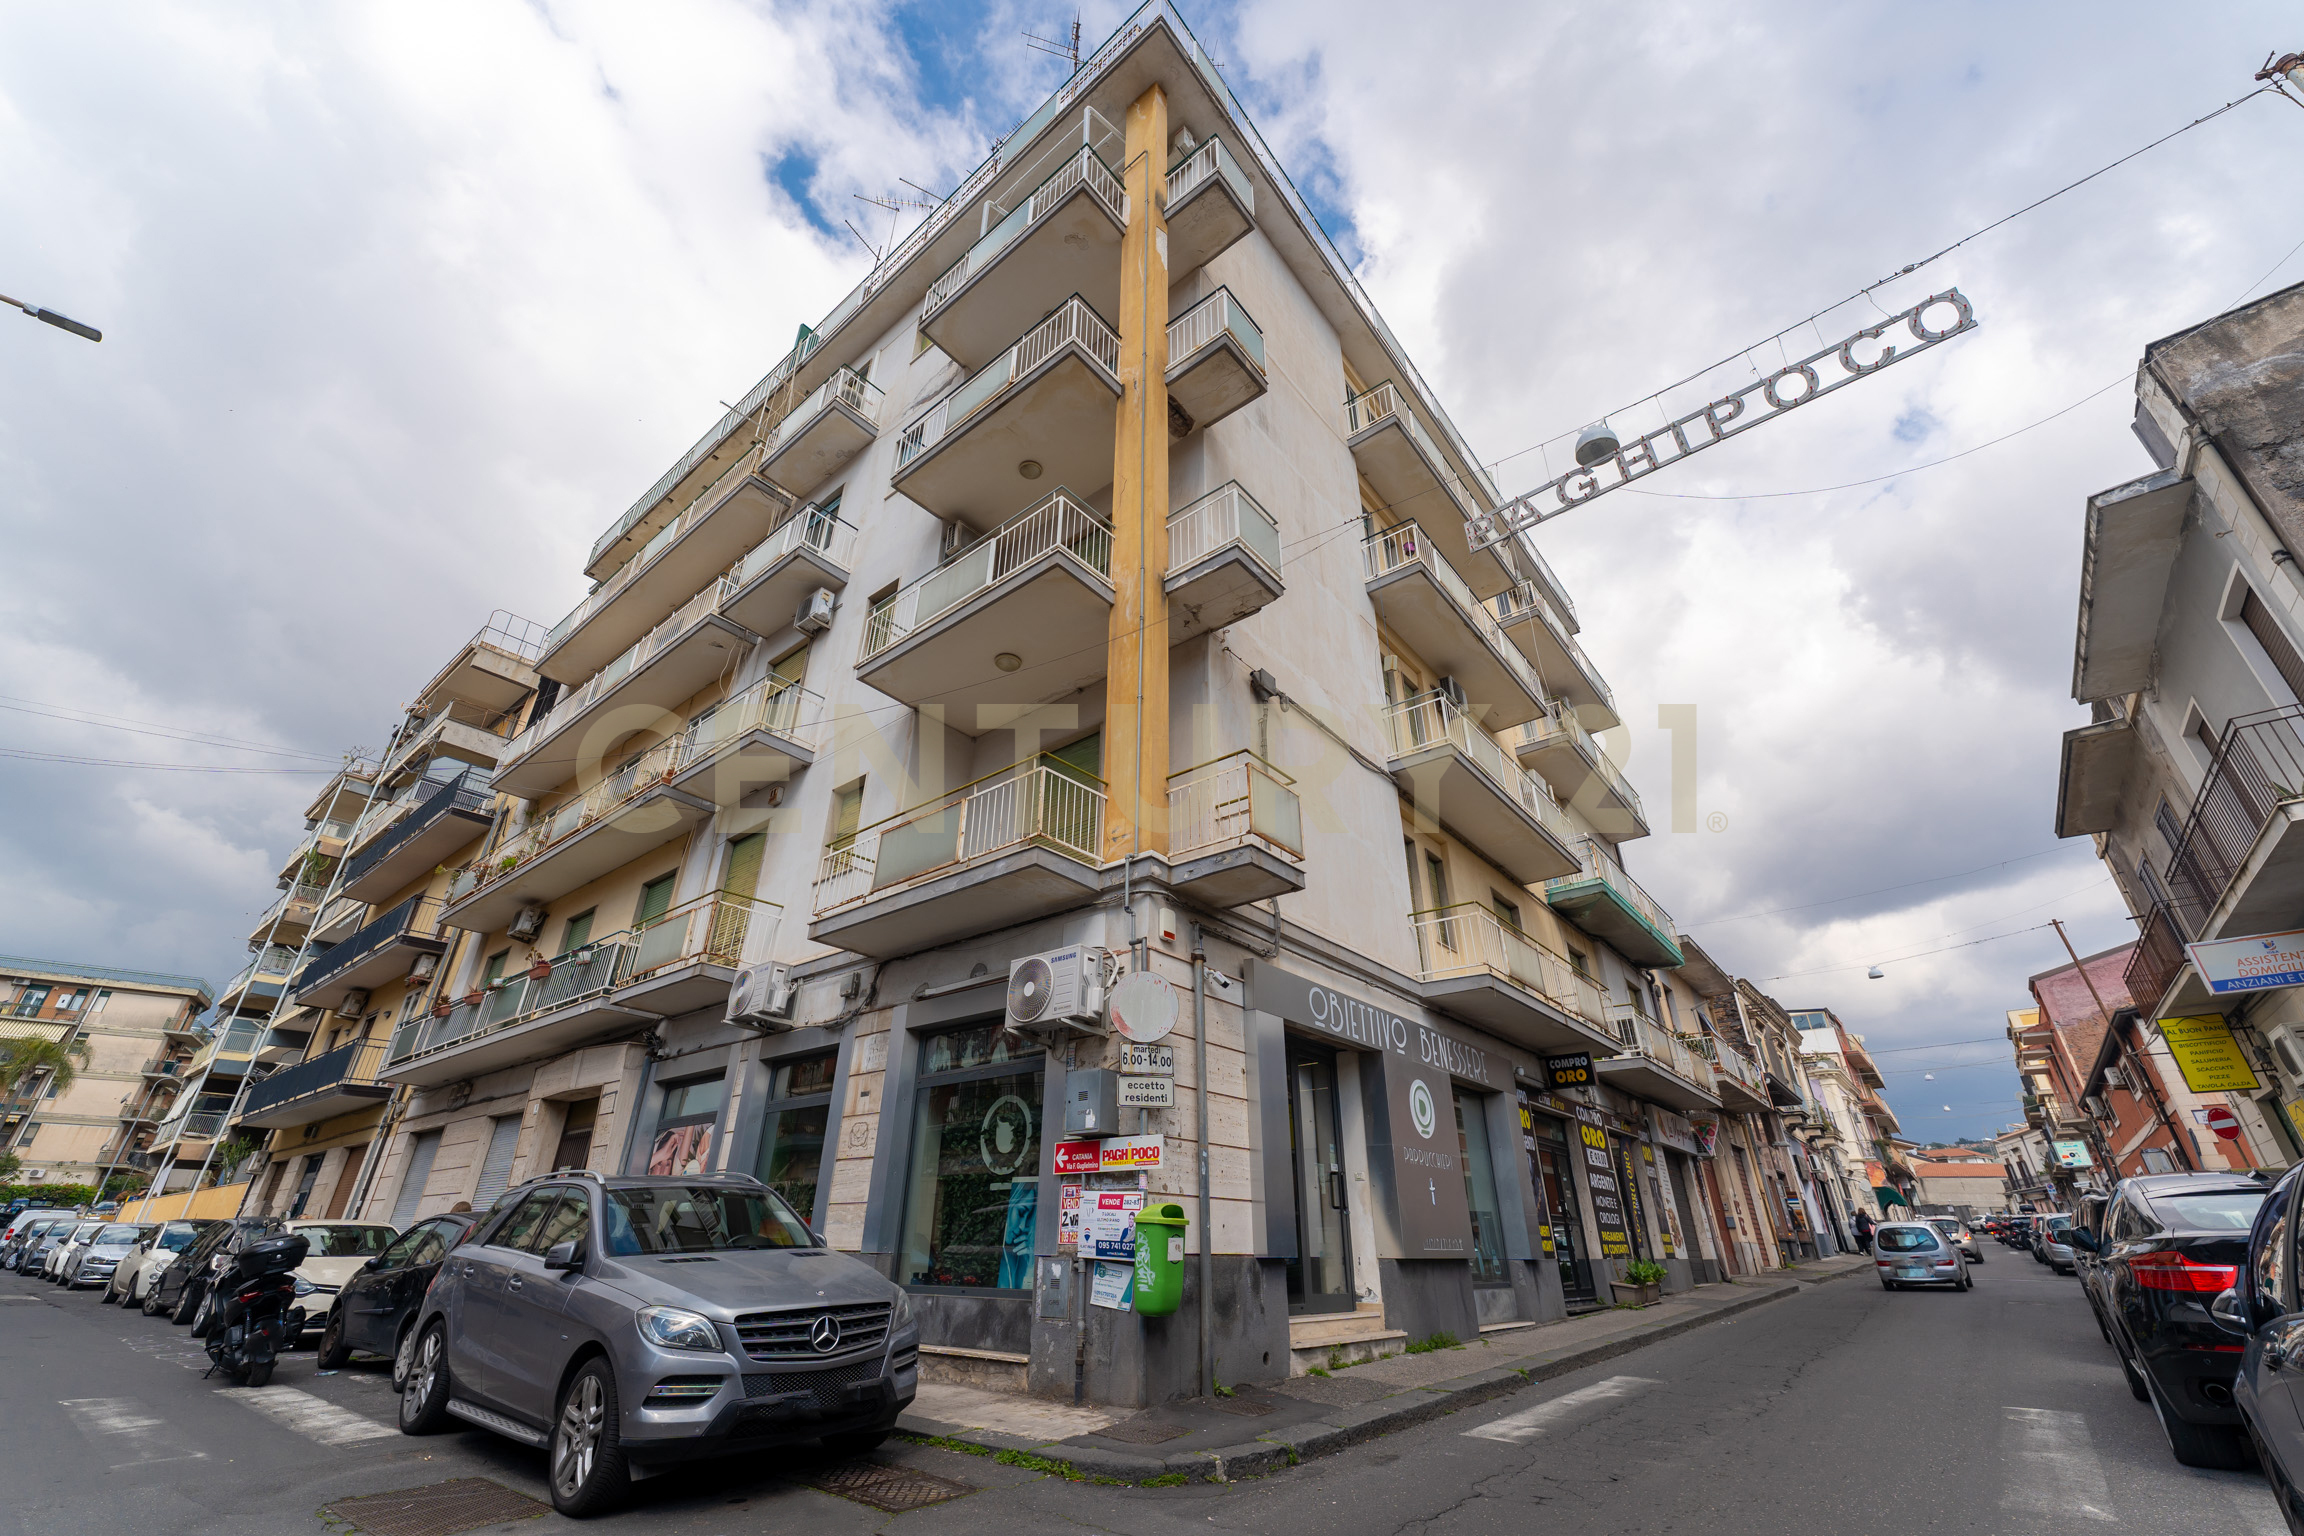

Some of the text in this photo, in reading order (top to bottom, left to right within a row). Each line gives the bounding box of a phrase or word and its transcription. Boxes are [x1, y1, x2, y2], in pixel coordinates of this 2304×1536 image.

[1050, 952, 1077, 963] SAMSUNG
[2227, 975, 2284, 990] ANZIANI
[2287, 973, 2297, 983] E
[1309, 986, 1489, 1084] OBIETTIVO BENESSERE
[2178, 1040, 2227, 1048] BISCOTTIFICIO
[1549, 1056, 1588, 1069] COMPRO
[1555, 1068, 1587, 1083] ORO
[1127, 1081, 1165, 1090] eccetto
[1125, 1093, 1168, 1102] residenti
[1575, 1105, 1603, 1127] COMPRO
[1581, 1125, 1606, 1149] ORO
[1072, 1152, 1093, 1160] CATANIA
[1403, 1146, 1454, 1170] PARRUCCHIERI
[1623, 1150, 1633, 1180] ORO
[1589, 1172, 1615, 1192] ARGENTO
[1063, 1198, 1079, 1209] VEND
[1101, 1198, 1121, 1206] VENDE
[1595, 1195, 1614, 1209] MONETE
[1061, 1211, 1069, 1227] 2
[1069, 1213, 1079, 1226] VA
[1599, 1211, 1621, 1225] OROLOGI
[1601, 1231, 1626, 1242] PAGAMENTI
[1098, 1241, 1110, 1249] 095
